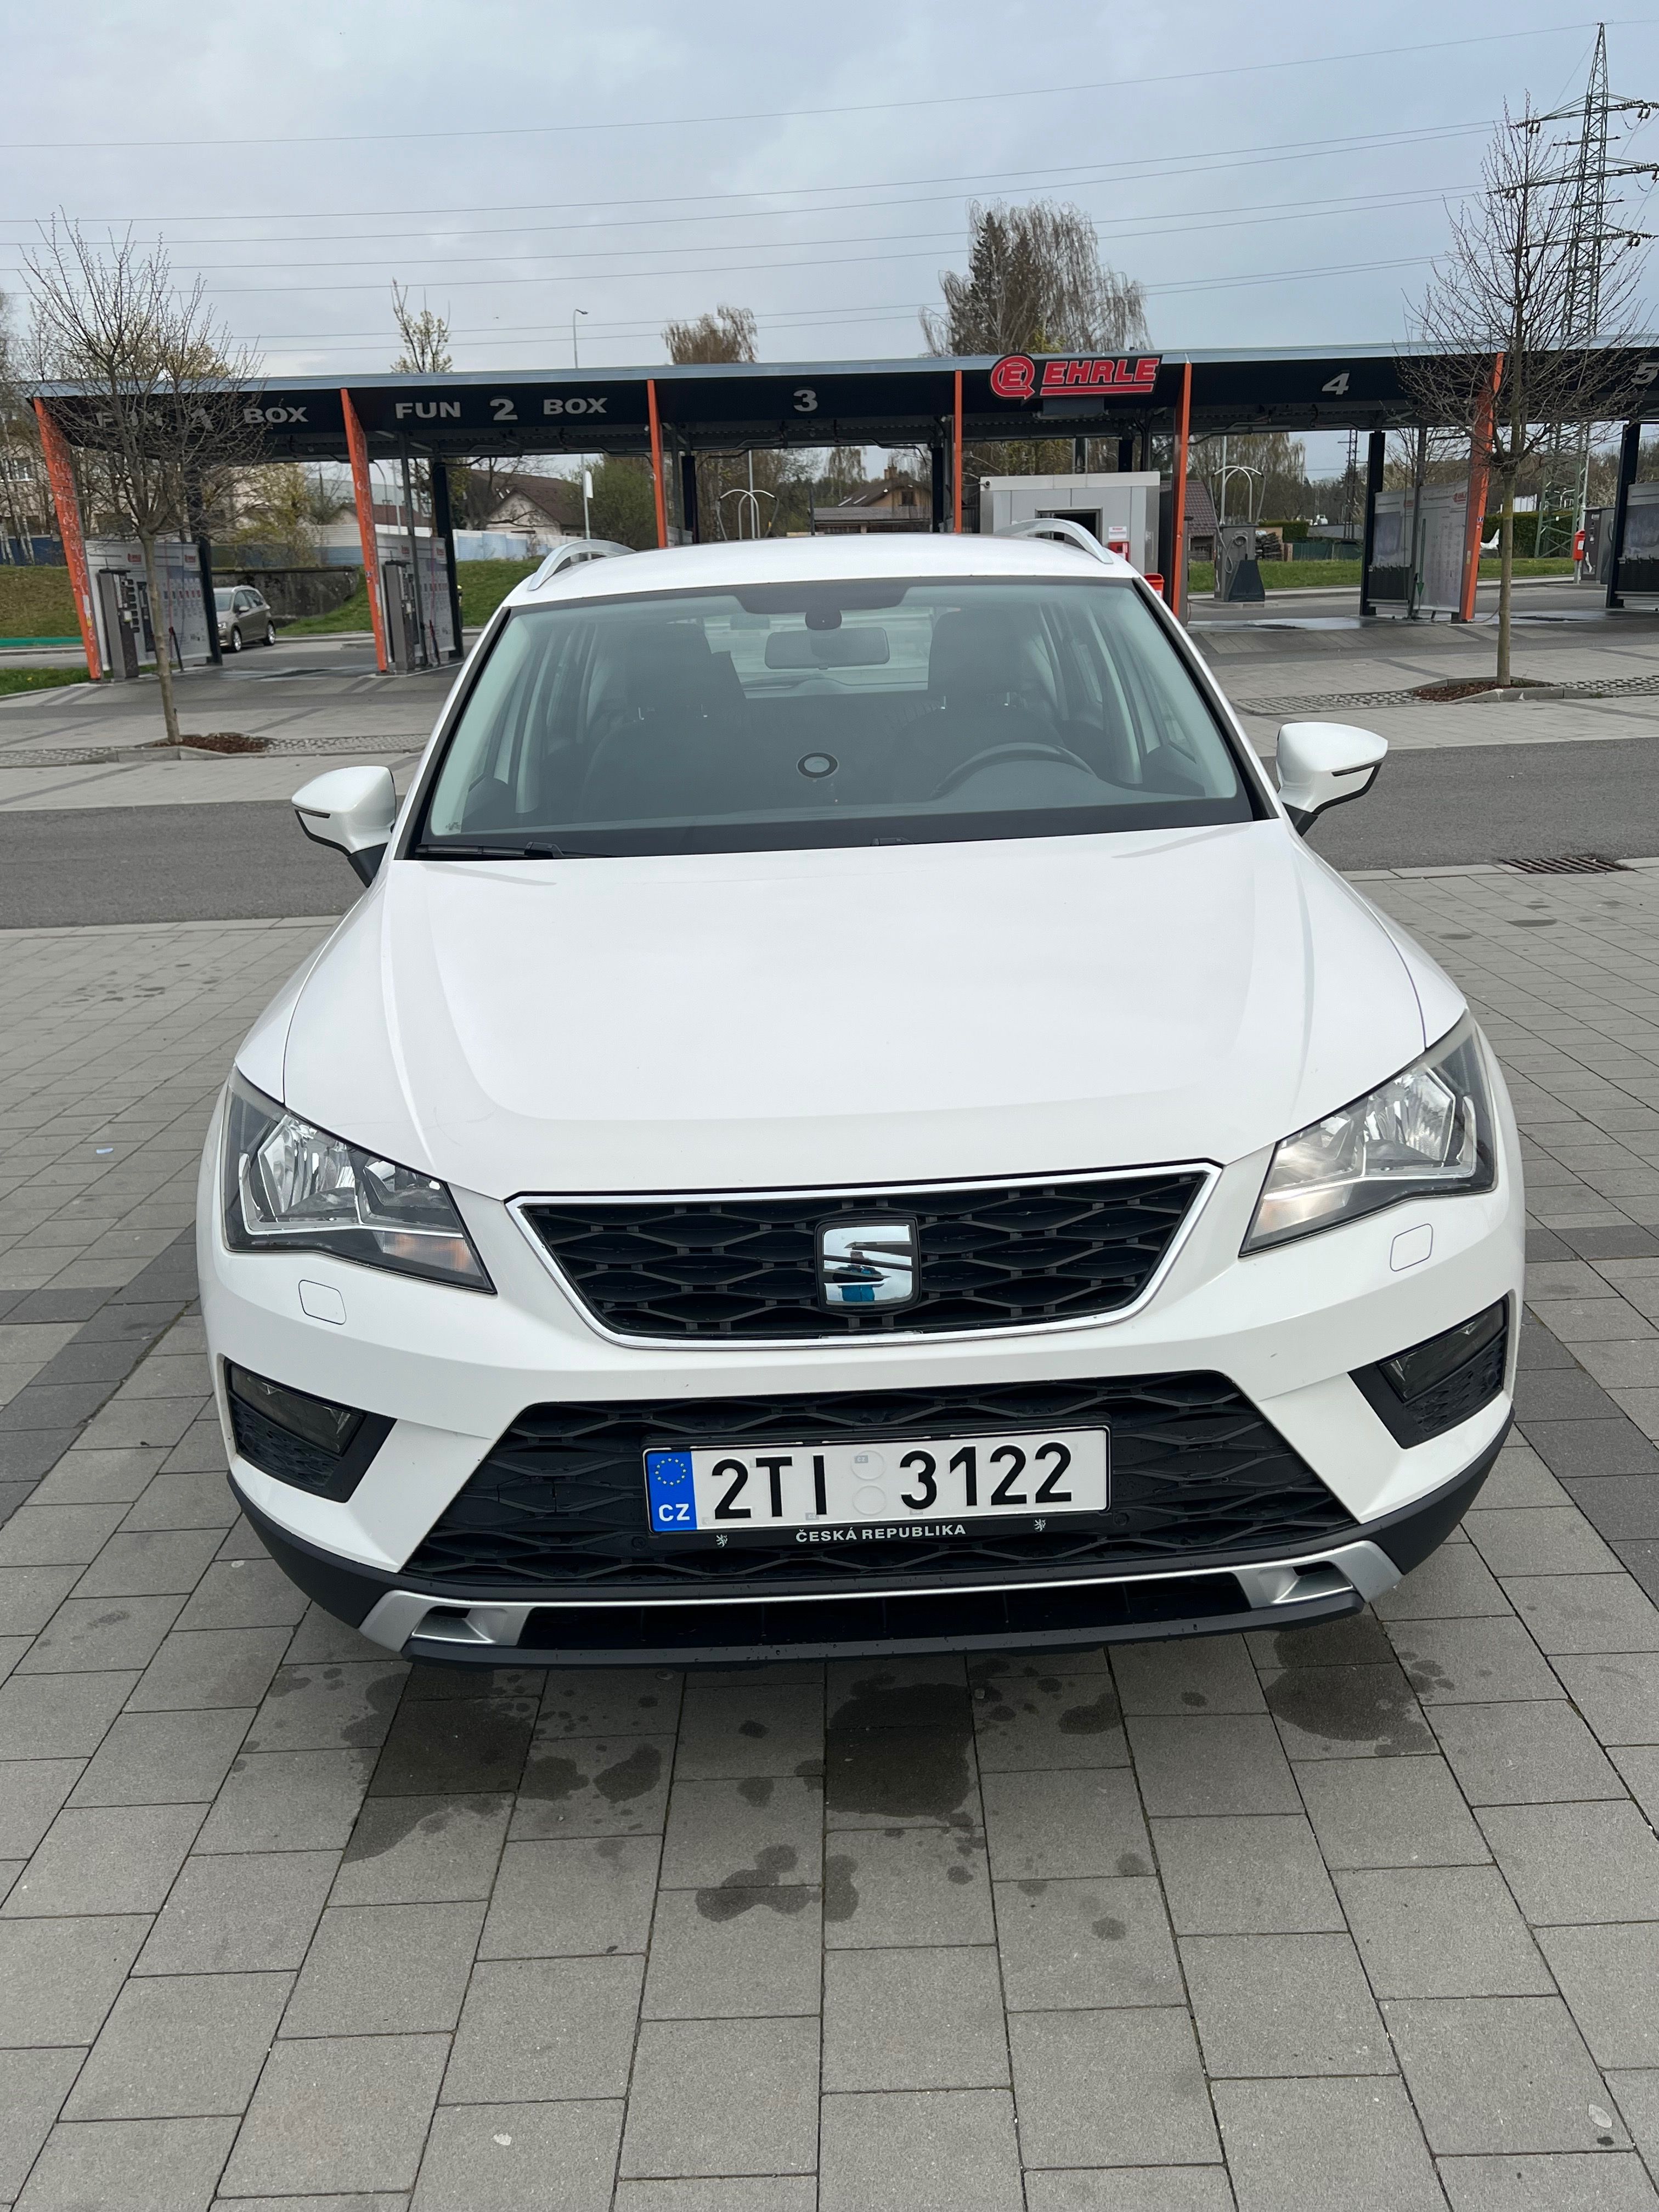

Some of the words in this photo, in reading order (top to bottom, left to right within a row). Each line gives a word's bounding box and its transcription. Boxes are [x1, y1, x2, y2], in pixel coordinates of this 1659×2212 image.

[1042, 358, 1160, 385] EHRLE
[1630, 362, 1659, 384] 5
[1322, 373, 1350, 395] 4
[395, 402, 461, 419] FUN
[490, 398, 518, 420] 2
[543, 398, 608, 415] BOX
[793, 390, 818, 411] 3
[242, 407, 308, 424] BOX
[712, 1455, 827, 1520] 2TI
[900, 1441, 1072, 1510] 3122
[658, 1503, 690, 1522] CZ
[796, 1527, 857, 1543] ČESKÁ
[862, 1524, 966, 1539] REPUBLIKA
